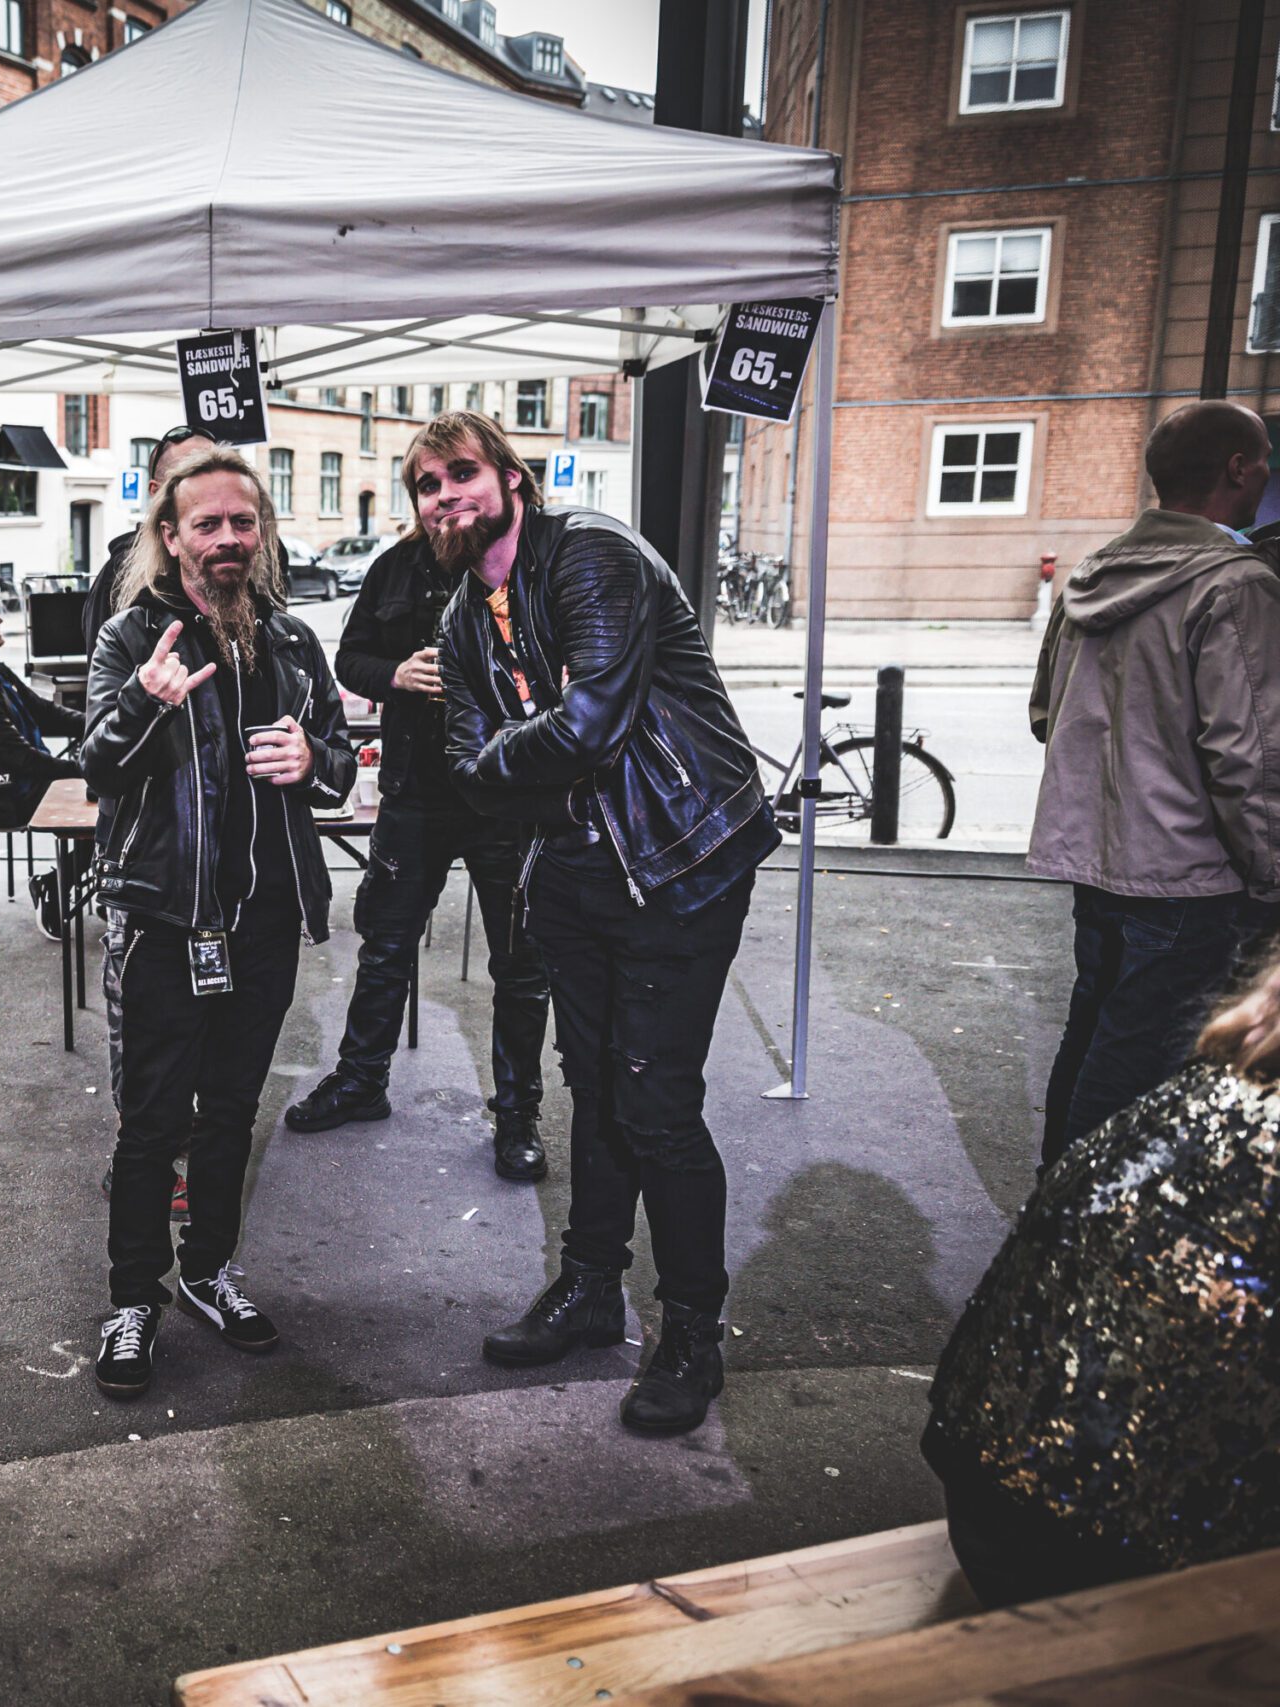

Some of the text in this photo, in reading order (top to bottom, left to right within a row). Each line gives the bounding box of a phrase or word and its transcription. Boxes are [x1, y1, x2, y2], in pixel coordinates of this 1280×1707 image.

[736, 314, 808, 339] SANDWICH
[730, 347, 792, 390] 65,-
[198, 387, 254, 421] 65,-
[558, 456, 572, 474] P
[125, 472, 136, 489] P
